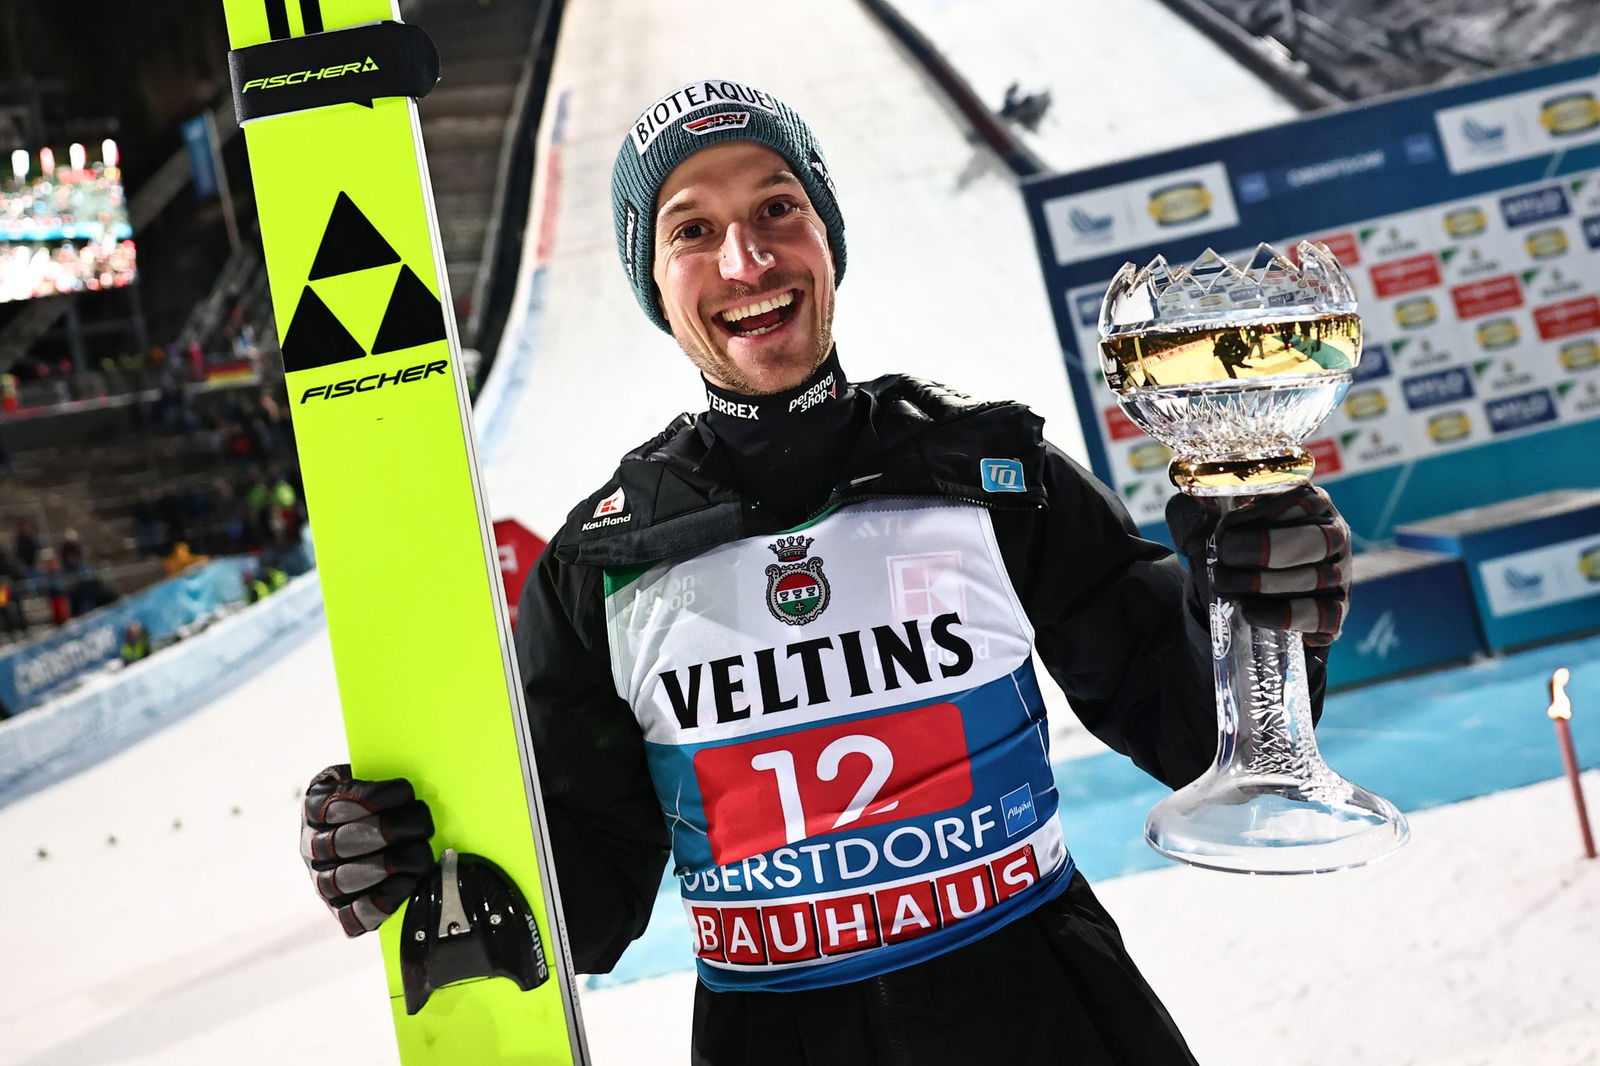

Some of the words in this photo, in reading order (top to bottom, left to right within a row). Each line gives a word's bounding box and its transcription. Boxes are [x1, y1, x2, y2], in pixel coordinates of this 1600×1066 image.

[242, 63, 360, 93] FISCHER
[636, 82, 773, 144] BIOTEAQUE
[300, 360, 447, 404] FISCHER
[788, 372, 834, 413] personal
[800, 389, 828, 413] shop
[707, 390, 760, 420] TERREX
[989, 465, 1020, 487] TQ
[581, 513, 632, 532] Kaufland
[659, 612, 975, 729] VELTINS
[751, 734, 899, 843] 12
[1007, 799, 1032, 820] Allgäu
[681, 805, 995, 892] OBERSTDORF
[697, 858, 1035, 953] BAUHAUS
[525, 914, 547, 978] Slatnar
